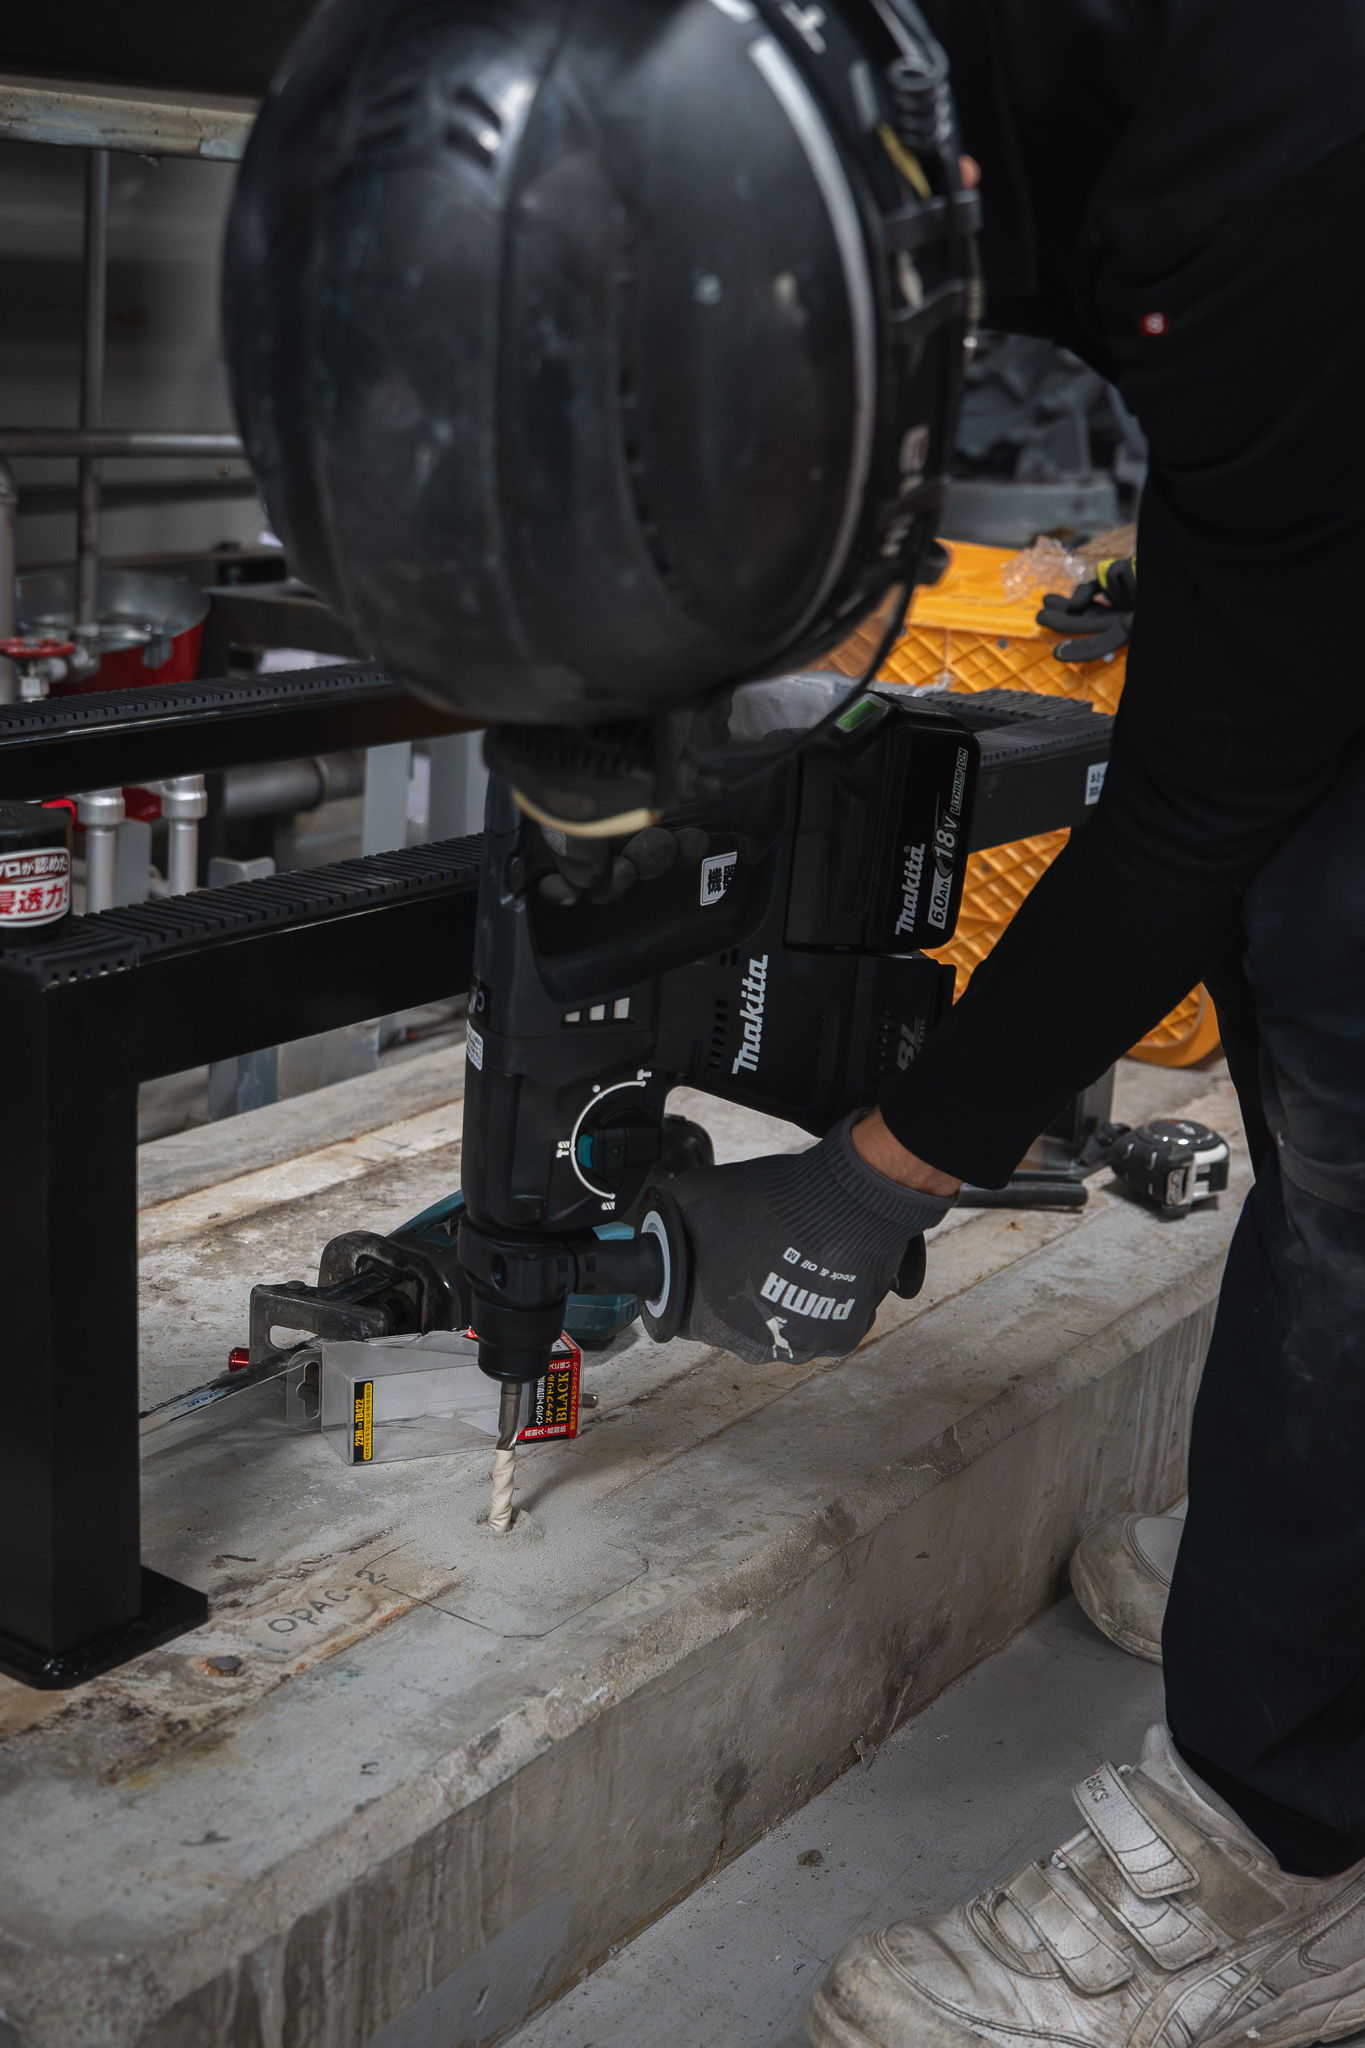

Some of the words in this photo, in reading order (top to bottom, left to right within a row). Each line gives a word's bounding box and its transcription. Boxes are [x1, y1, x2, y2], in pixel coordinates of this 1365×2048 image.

[933, 814, 959, 861] 18V
[931, 880, 950, 925] 6.0Ah
[760, 1271, 856, 1320] PUMA
[546, 1374, 555, 1424] ステップドリル
[556, 1371, 570, 1423] BLACK
